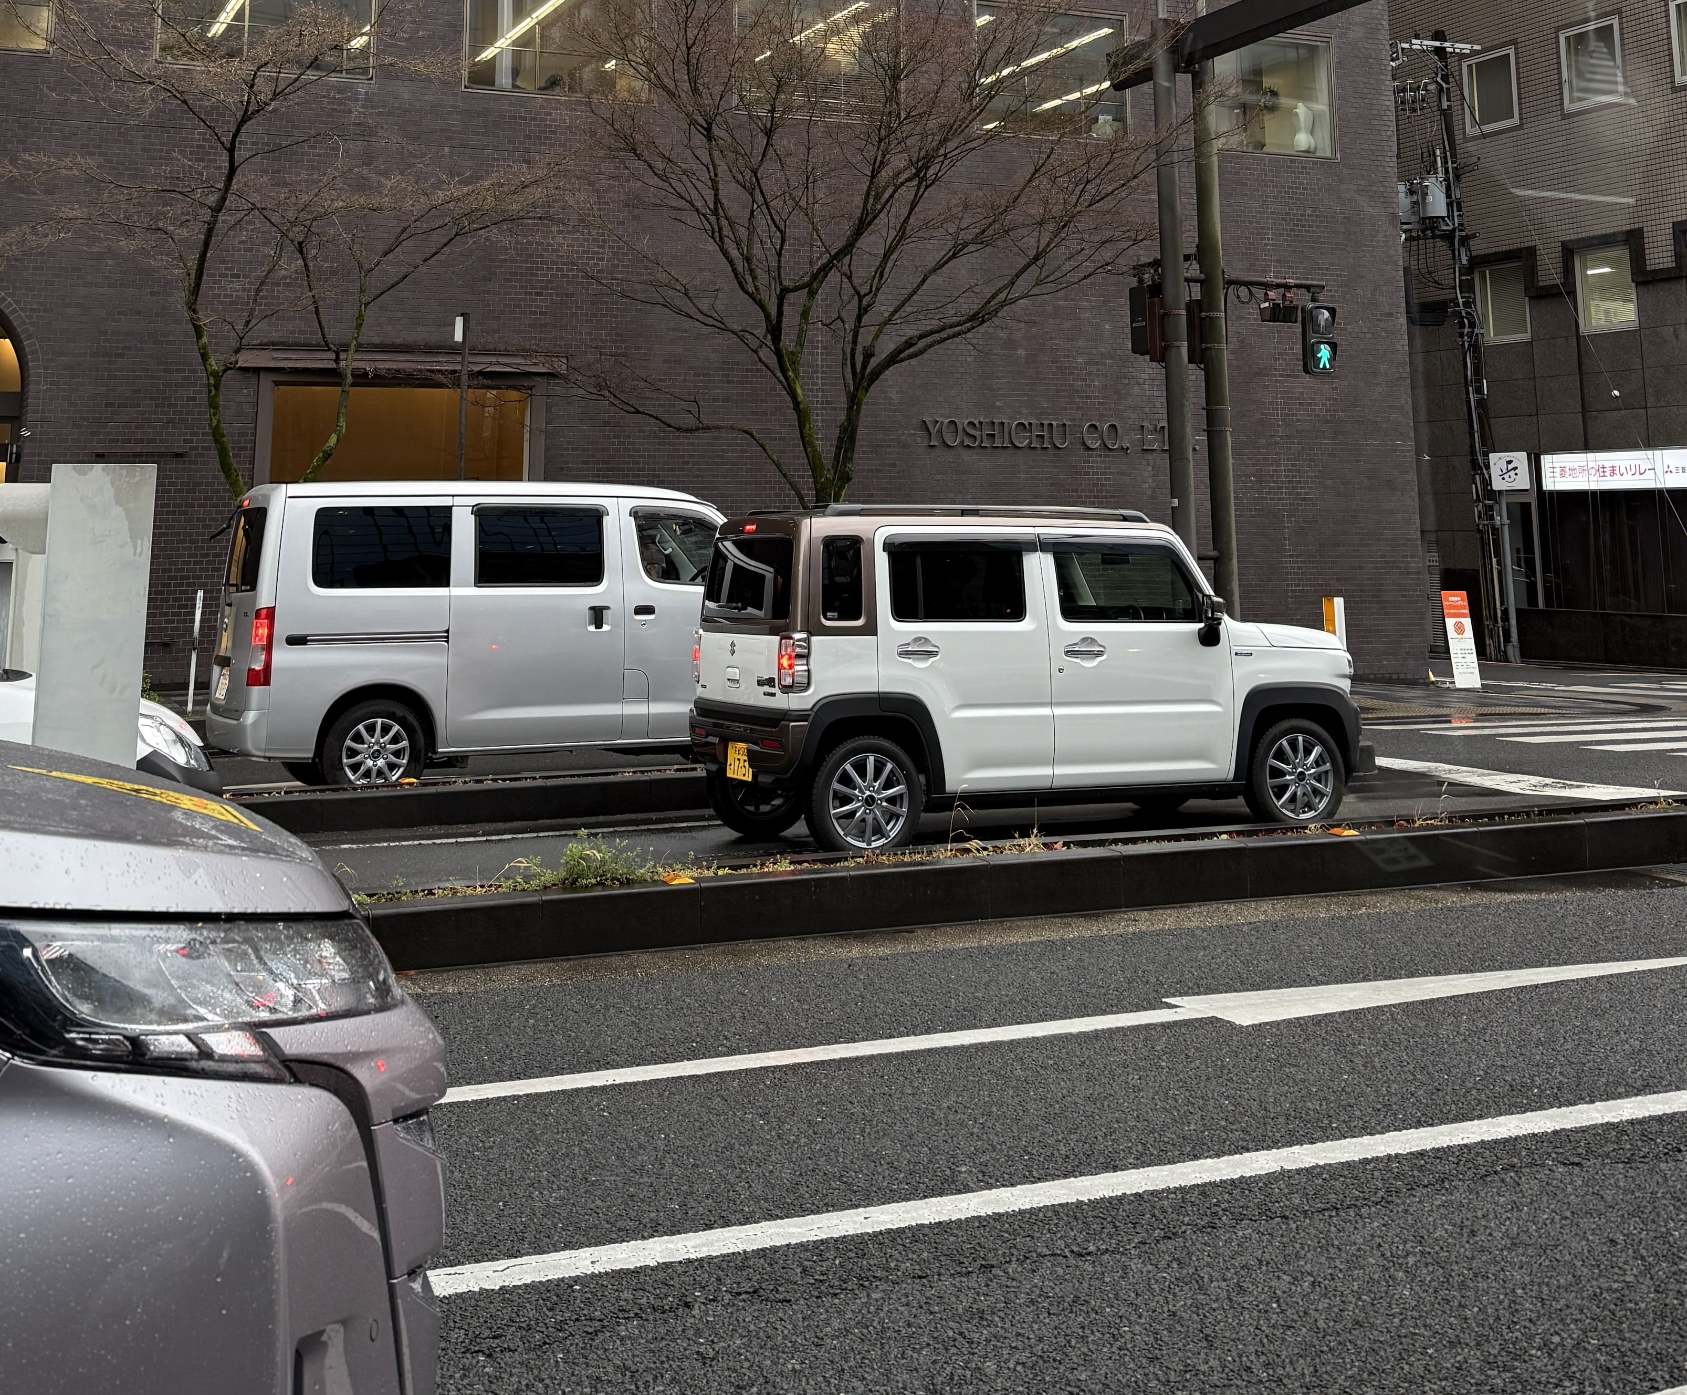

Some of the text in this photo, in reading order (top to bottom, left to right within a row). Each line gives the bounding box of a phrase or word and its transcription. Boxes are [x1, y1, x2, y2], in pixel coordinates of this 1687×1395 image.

[923, 417, 1071, 448] YOSHICHU
[1082, 422, 1131, 454] CO.,
[1548, 464, 1655, 479] 三菱地所の住まいリレー
